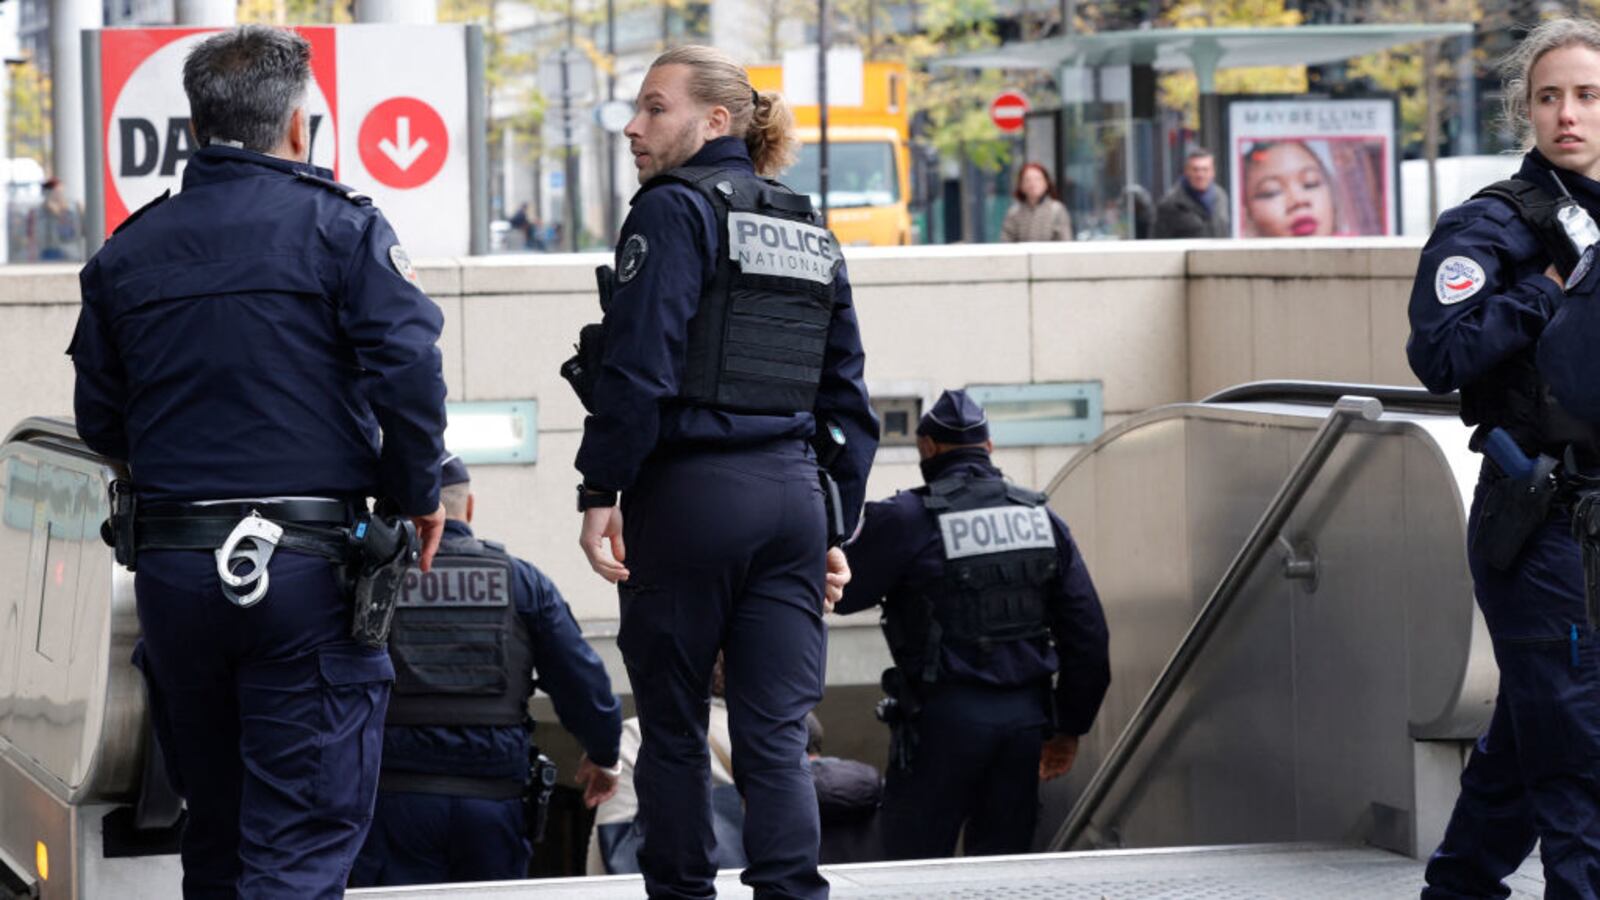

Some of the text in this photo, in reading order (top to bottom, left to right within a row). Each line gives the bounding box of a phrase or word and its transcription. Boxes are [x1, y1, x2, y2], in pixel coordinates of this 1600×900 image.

[1245, 109, 1376, 124] MAYBELLINE
[736, 220, 832, 260] POLICE
[948, 511, 1048, 551] POLICE
[402, 570, 503, 602] POLICE
